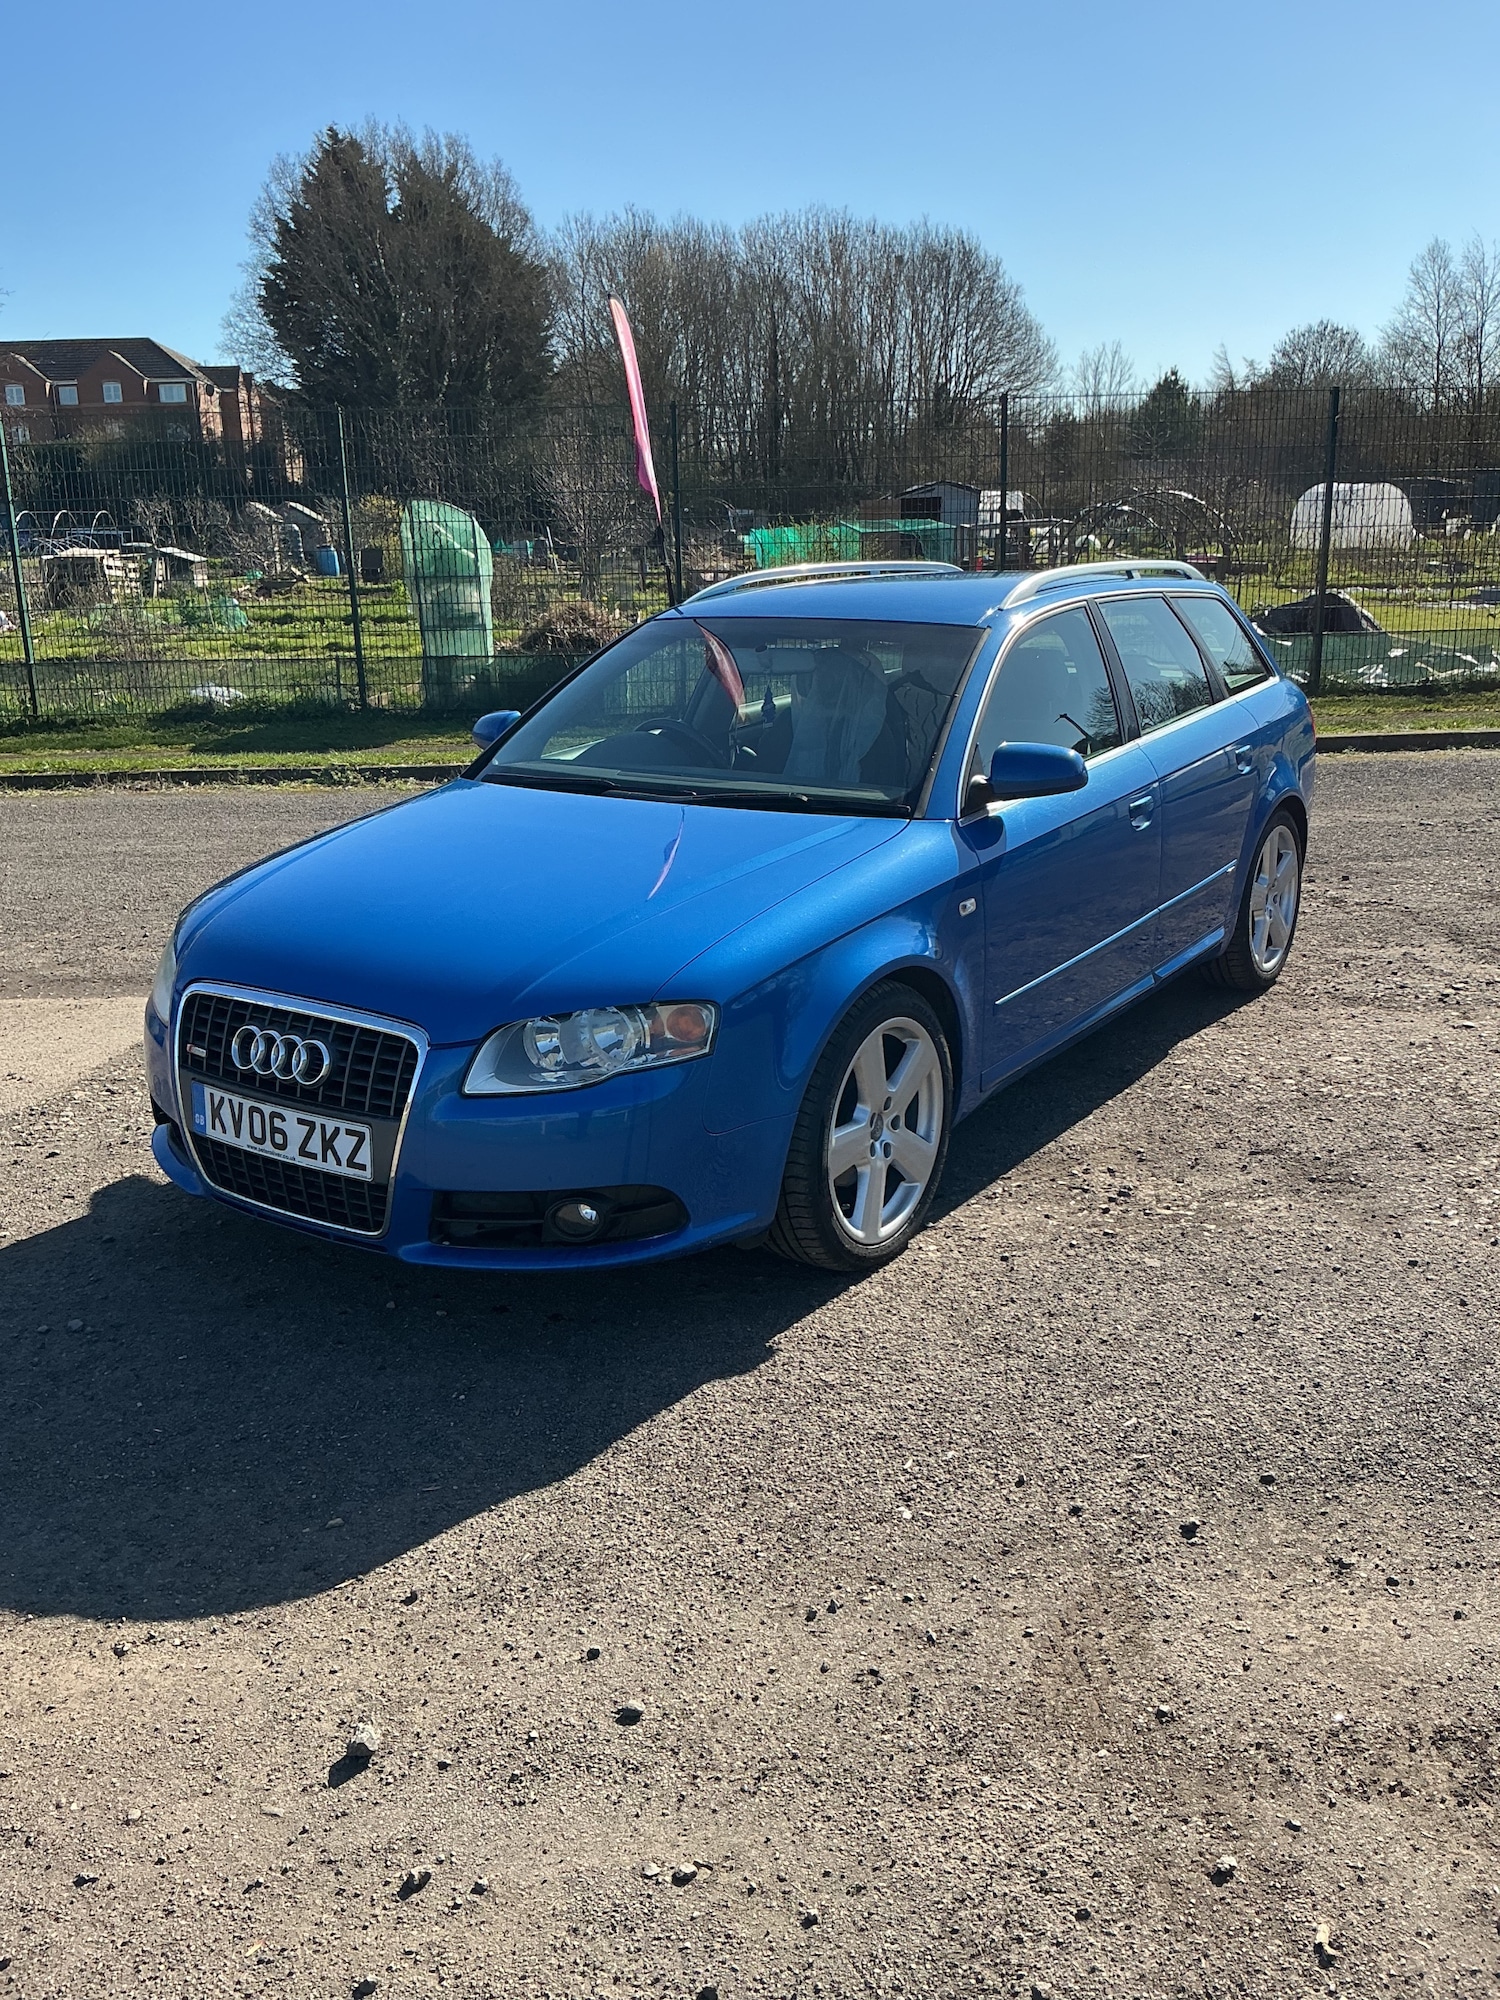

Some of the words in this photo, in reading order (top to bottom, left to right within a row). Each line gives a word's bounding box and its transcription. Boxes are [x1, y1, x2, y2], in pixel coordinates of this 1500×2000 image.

[195, 1113, 205, 1126] GB
[209, 1093, 288, 1151] KV06
[296, 1117, 368, 1172] ZKZ
